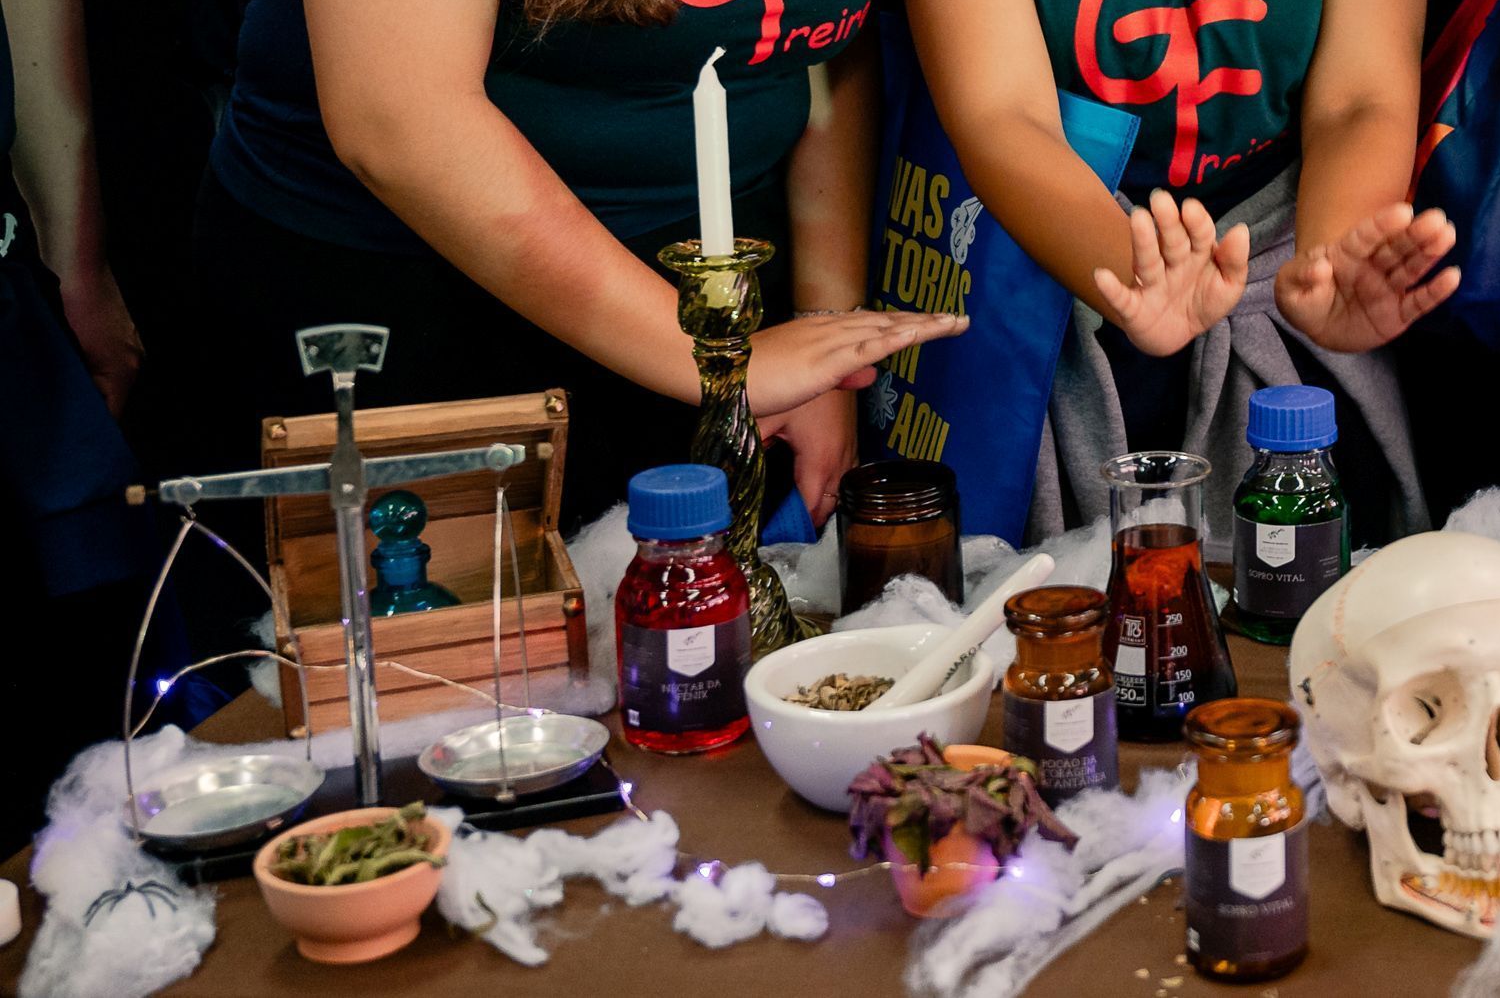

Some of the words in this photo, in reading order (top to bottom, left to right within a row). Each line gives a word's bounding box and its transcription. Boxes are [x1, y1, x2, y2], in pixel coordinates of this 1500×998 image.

[1276, 574, 1305, 582] VITAL
[1164, 613, 1183, 626] 250
[1170, 645, 1188, 658] 200
[1174, 668, 1192, 682] 150
[1178, 690, 1195, 703] 100
